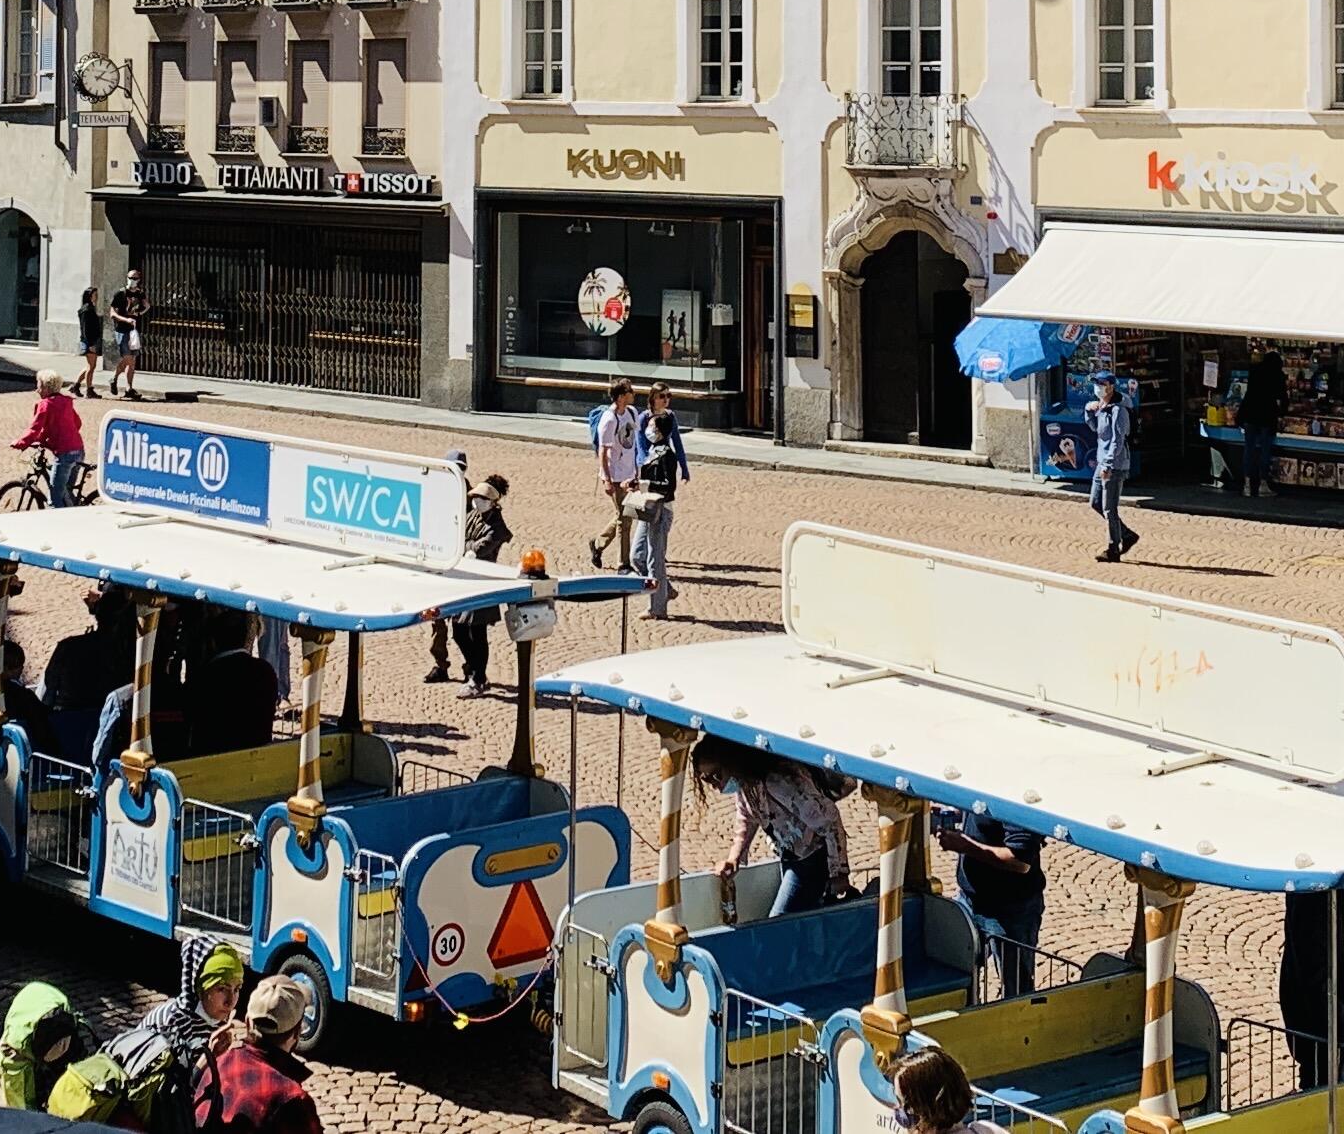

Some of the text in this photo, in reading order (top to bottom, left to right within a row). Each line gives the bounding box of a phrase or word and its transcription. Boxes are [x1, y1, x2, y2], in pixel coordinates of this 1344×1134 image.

[80, 115, 128, 124] TETTAMANTI
[131, 162, 193, 186] RADO
[567, 148, 681, 175] KUONI
[1148, 151, 1323, 195] k kiosk
[215, 165, 319, 190] TETTAMANTI
[107, 428, 192, 477] Allianz
[106, 478, 134, 495] Agenzia
[134, 485, 166, 500] generale
[220, 498, 261, 517] Bellinzona
[440, 935, 457, 955] 30
